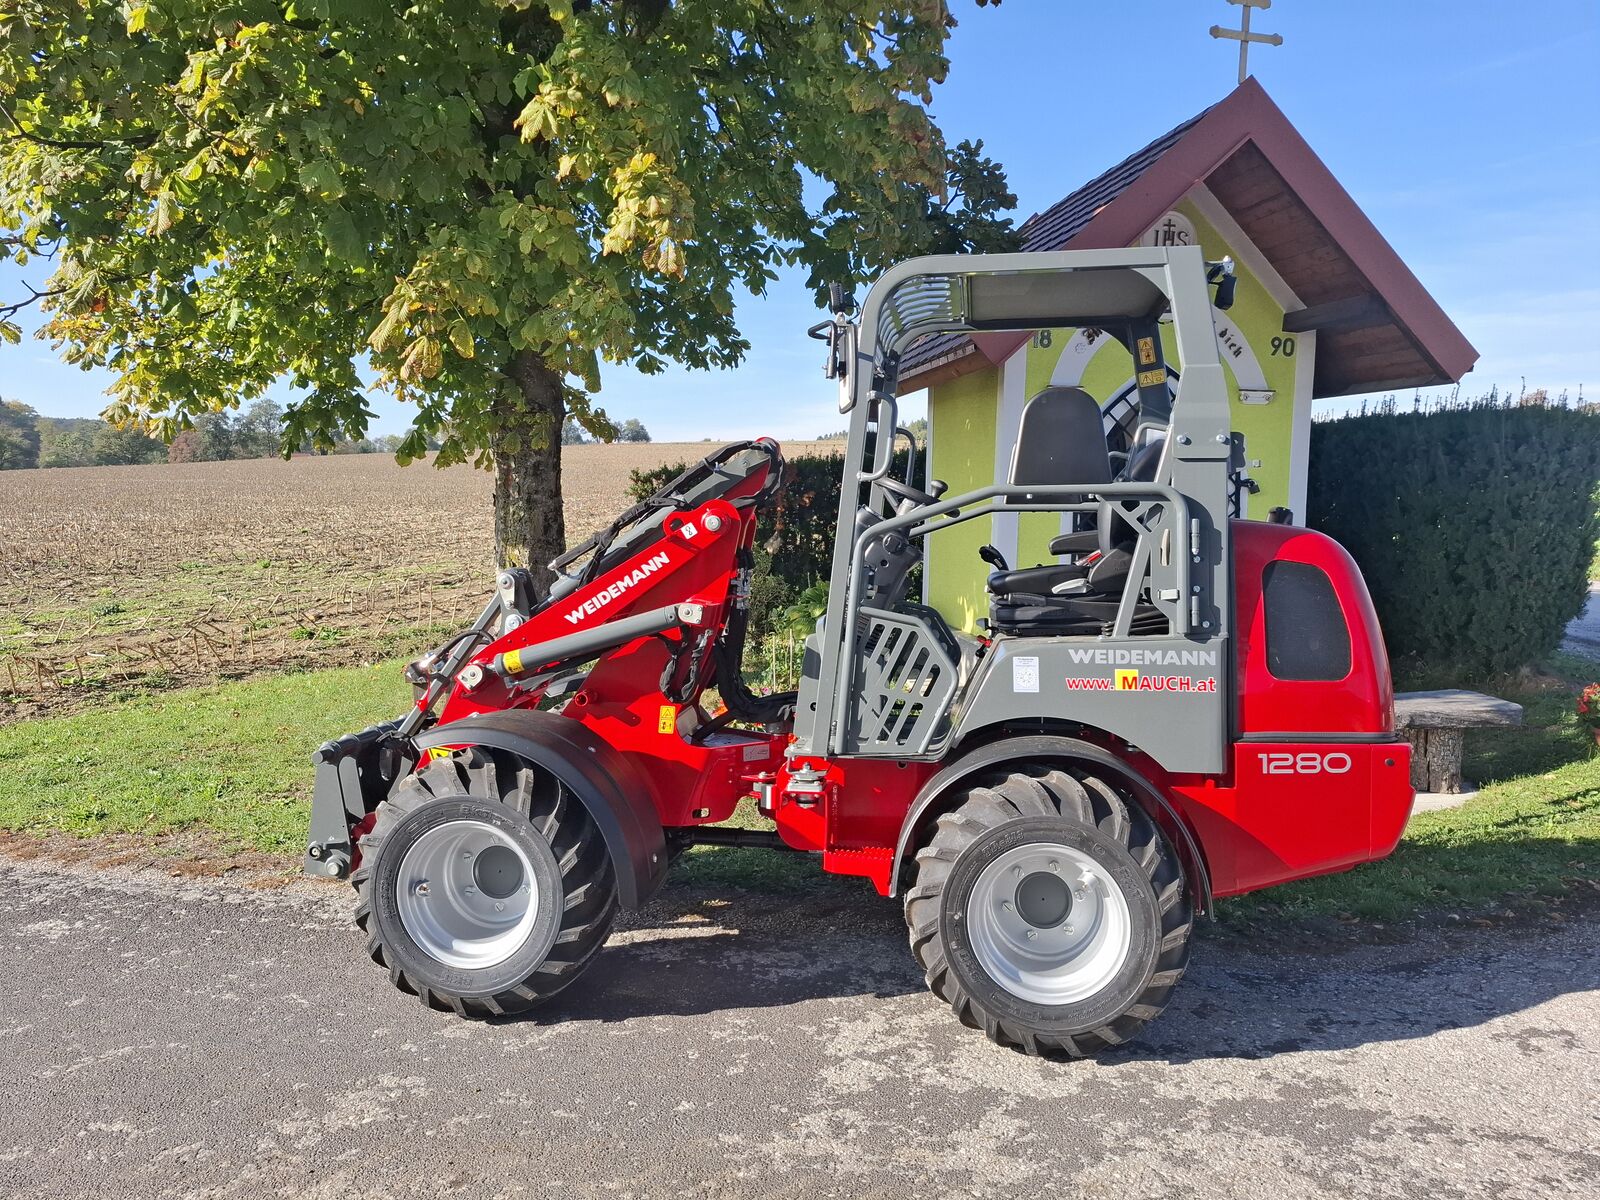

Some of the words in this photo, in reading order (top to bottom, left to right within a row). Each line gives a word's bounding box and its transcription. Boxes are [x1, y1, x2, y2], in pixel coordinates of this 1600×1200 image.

[1270, 336, 1295, 357] 90
[564, 551, 670, 625] WEIDEMANN
[1068, 648, 1217, 666] WEIDEMANN
[1257, 752, 1352, 775] 1280
